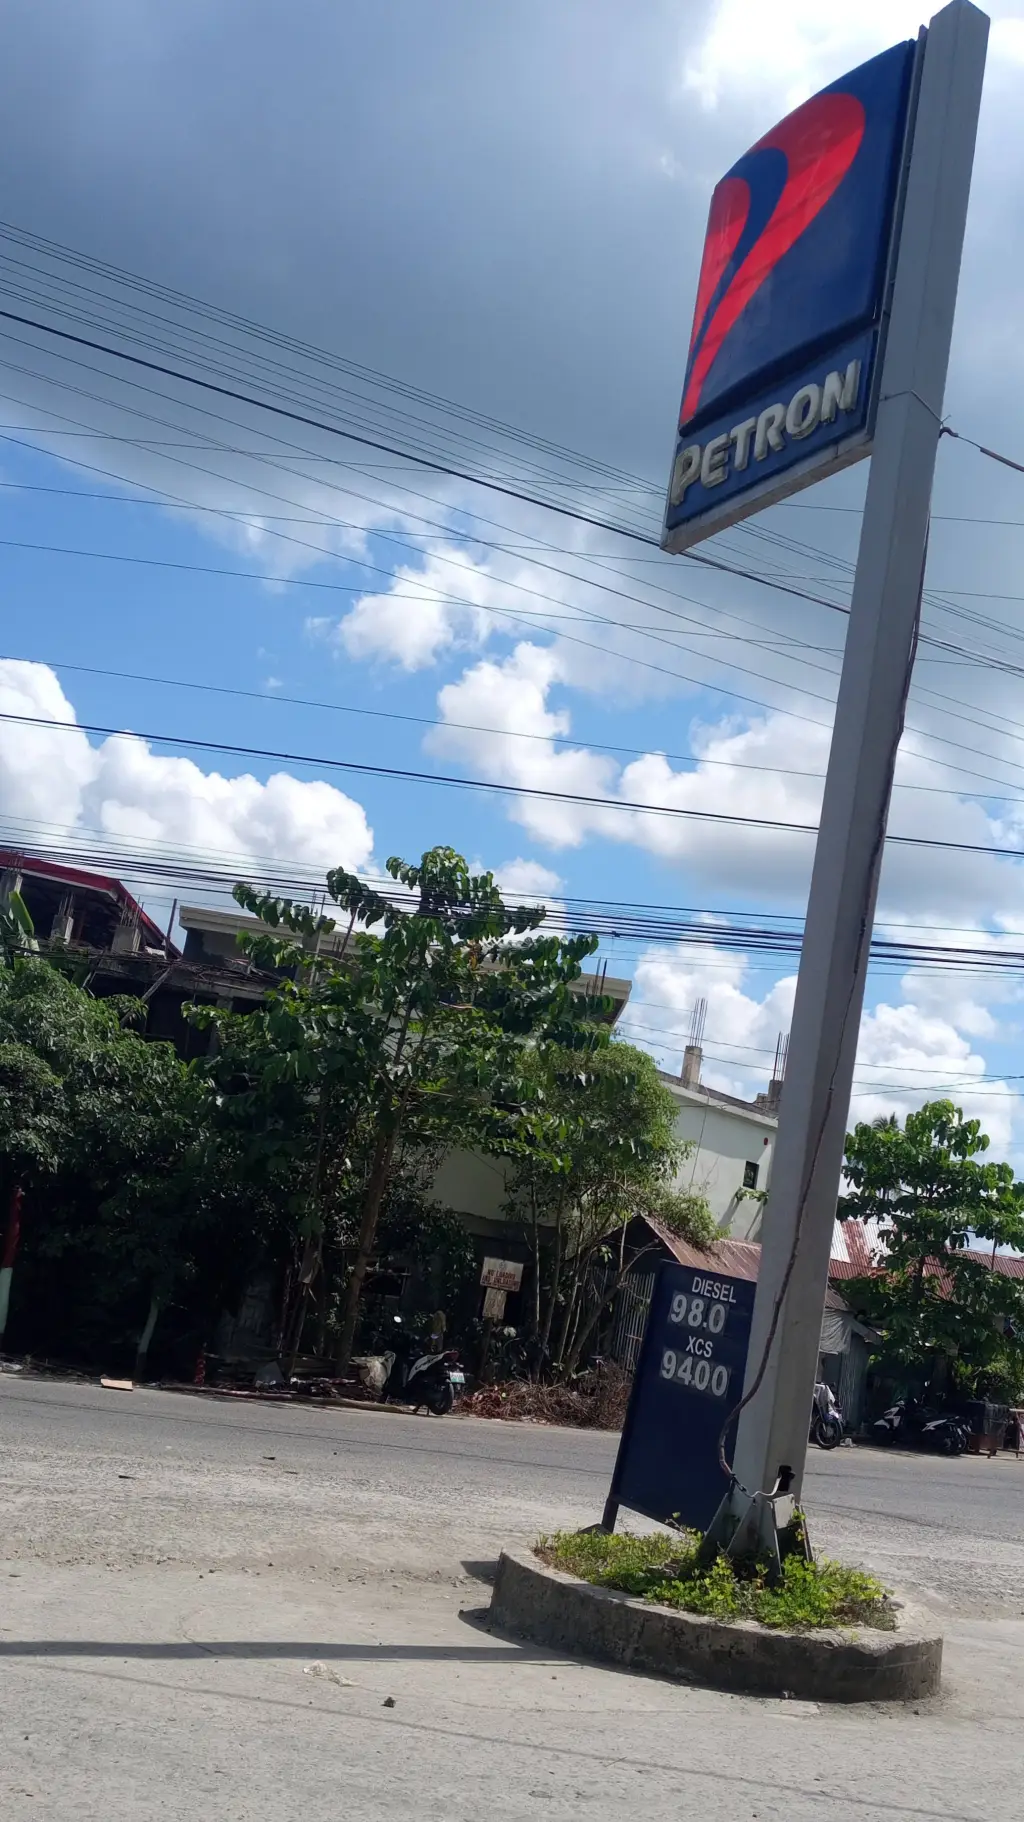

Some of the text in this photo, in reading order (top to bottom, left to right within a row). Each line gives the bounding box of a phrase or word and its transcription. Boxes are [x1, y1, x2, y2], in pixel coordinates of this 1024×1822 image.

[669, 358, 861, 506] PETRON
[691, 1276, 737, 1303] DIESEL
[670, 1294, 726, 1334] 98.0
[685, 1335, 713, 1358] XCS
